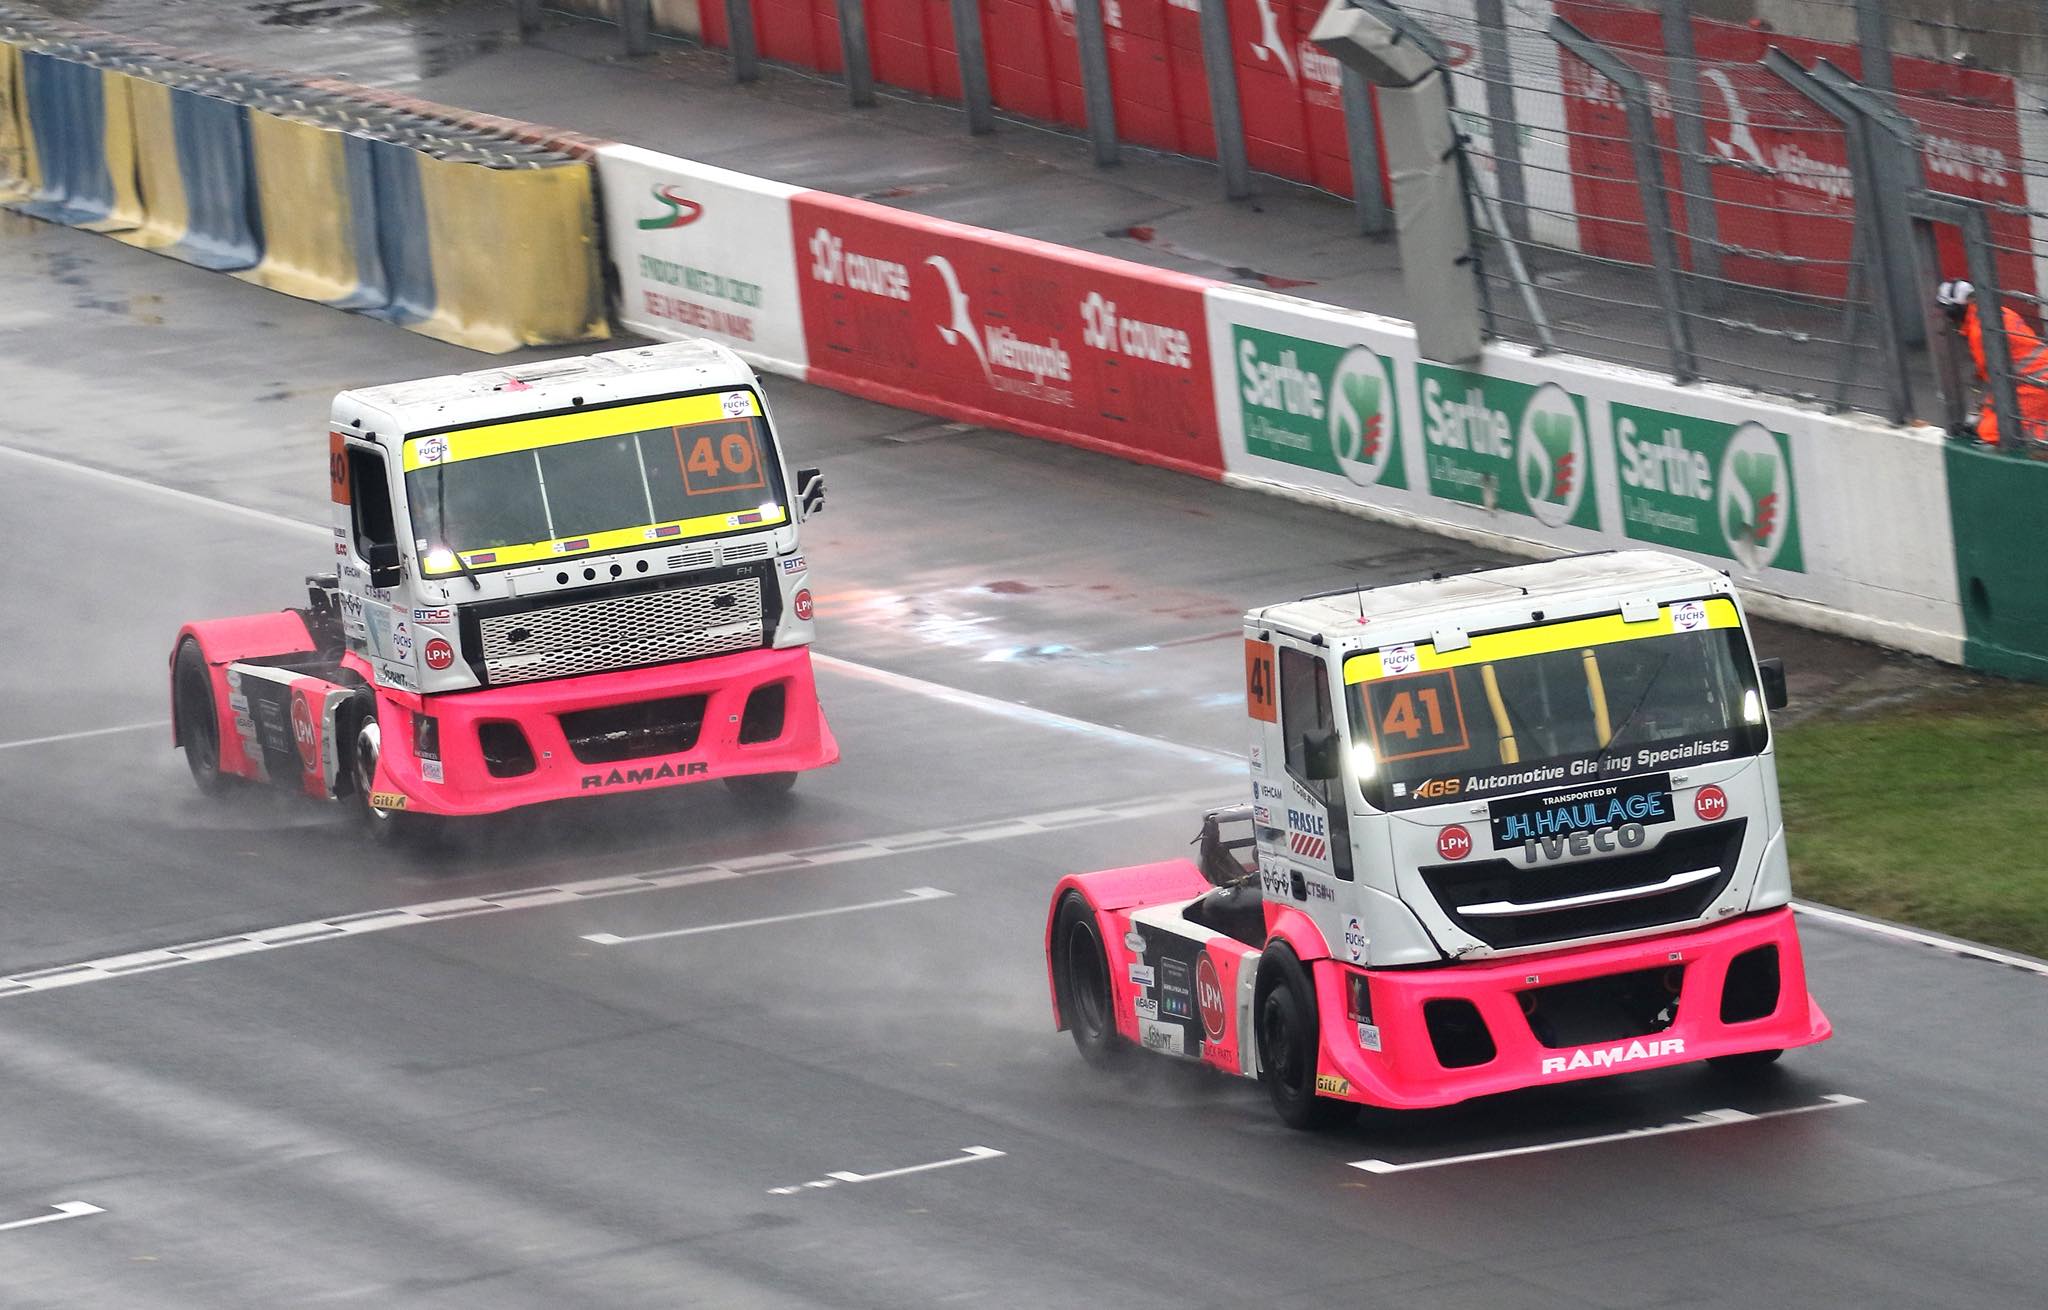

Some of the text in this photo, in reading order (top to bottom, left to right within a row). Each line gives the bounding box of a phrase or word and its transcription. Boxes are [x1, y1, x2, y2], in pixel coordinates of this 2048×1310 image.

[1239, 338, 1326, 421] Sarthe
[723, 400, 750, 409] FUCHS
[1423, 377, 1514, 460] Sarthe
[419, 444, 448, 456] FUCHS
[687, 433, 753, 477] 40
[1616, 417, 1714, 502] Sarthe
[736, 566, 753, 576] FH
[413, 609, 450, 619] BTRC
[796, 600, 812, 612] LPM
[1673, 609, 1706, 622] FUCHS
[393, 634, 412, 648] FUCHS
[426, 649, 451, 661] LPM
[1383, 653, 1416, 667] FUCHS
[1251, 656, 1273, 706] 41
[1382, 688, 1445, 740] 41
[294, 718, 314, 745] LPM
[1465, 766, 1565, 793] Automotive
[1570, 755, 1632, 776] Glaing
[1638, 739, 1730, 768] Specialists
[581, 762, 709, 790] RAMAIR
[373, 795, 394, 806] Giti
[1543, 786, 1618, 805] TRANSPORTED BY
[1697, 795, 1726, 811] LPM
[1440, 836, 1470, 851] LPM
[1524, 822, 1646, 864] IVECO
[1345, 932, 1365, 948] FUCHS
[1200, 981, 1223, 1013] LPM
[1542, 1038, 1686, 1075] RAMAIR
[1317, 1077, 1337, 1092] Giti
